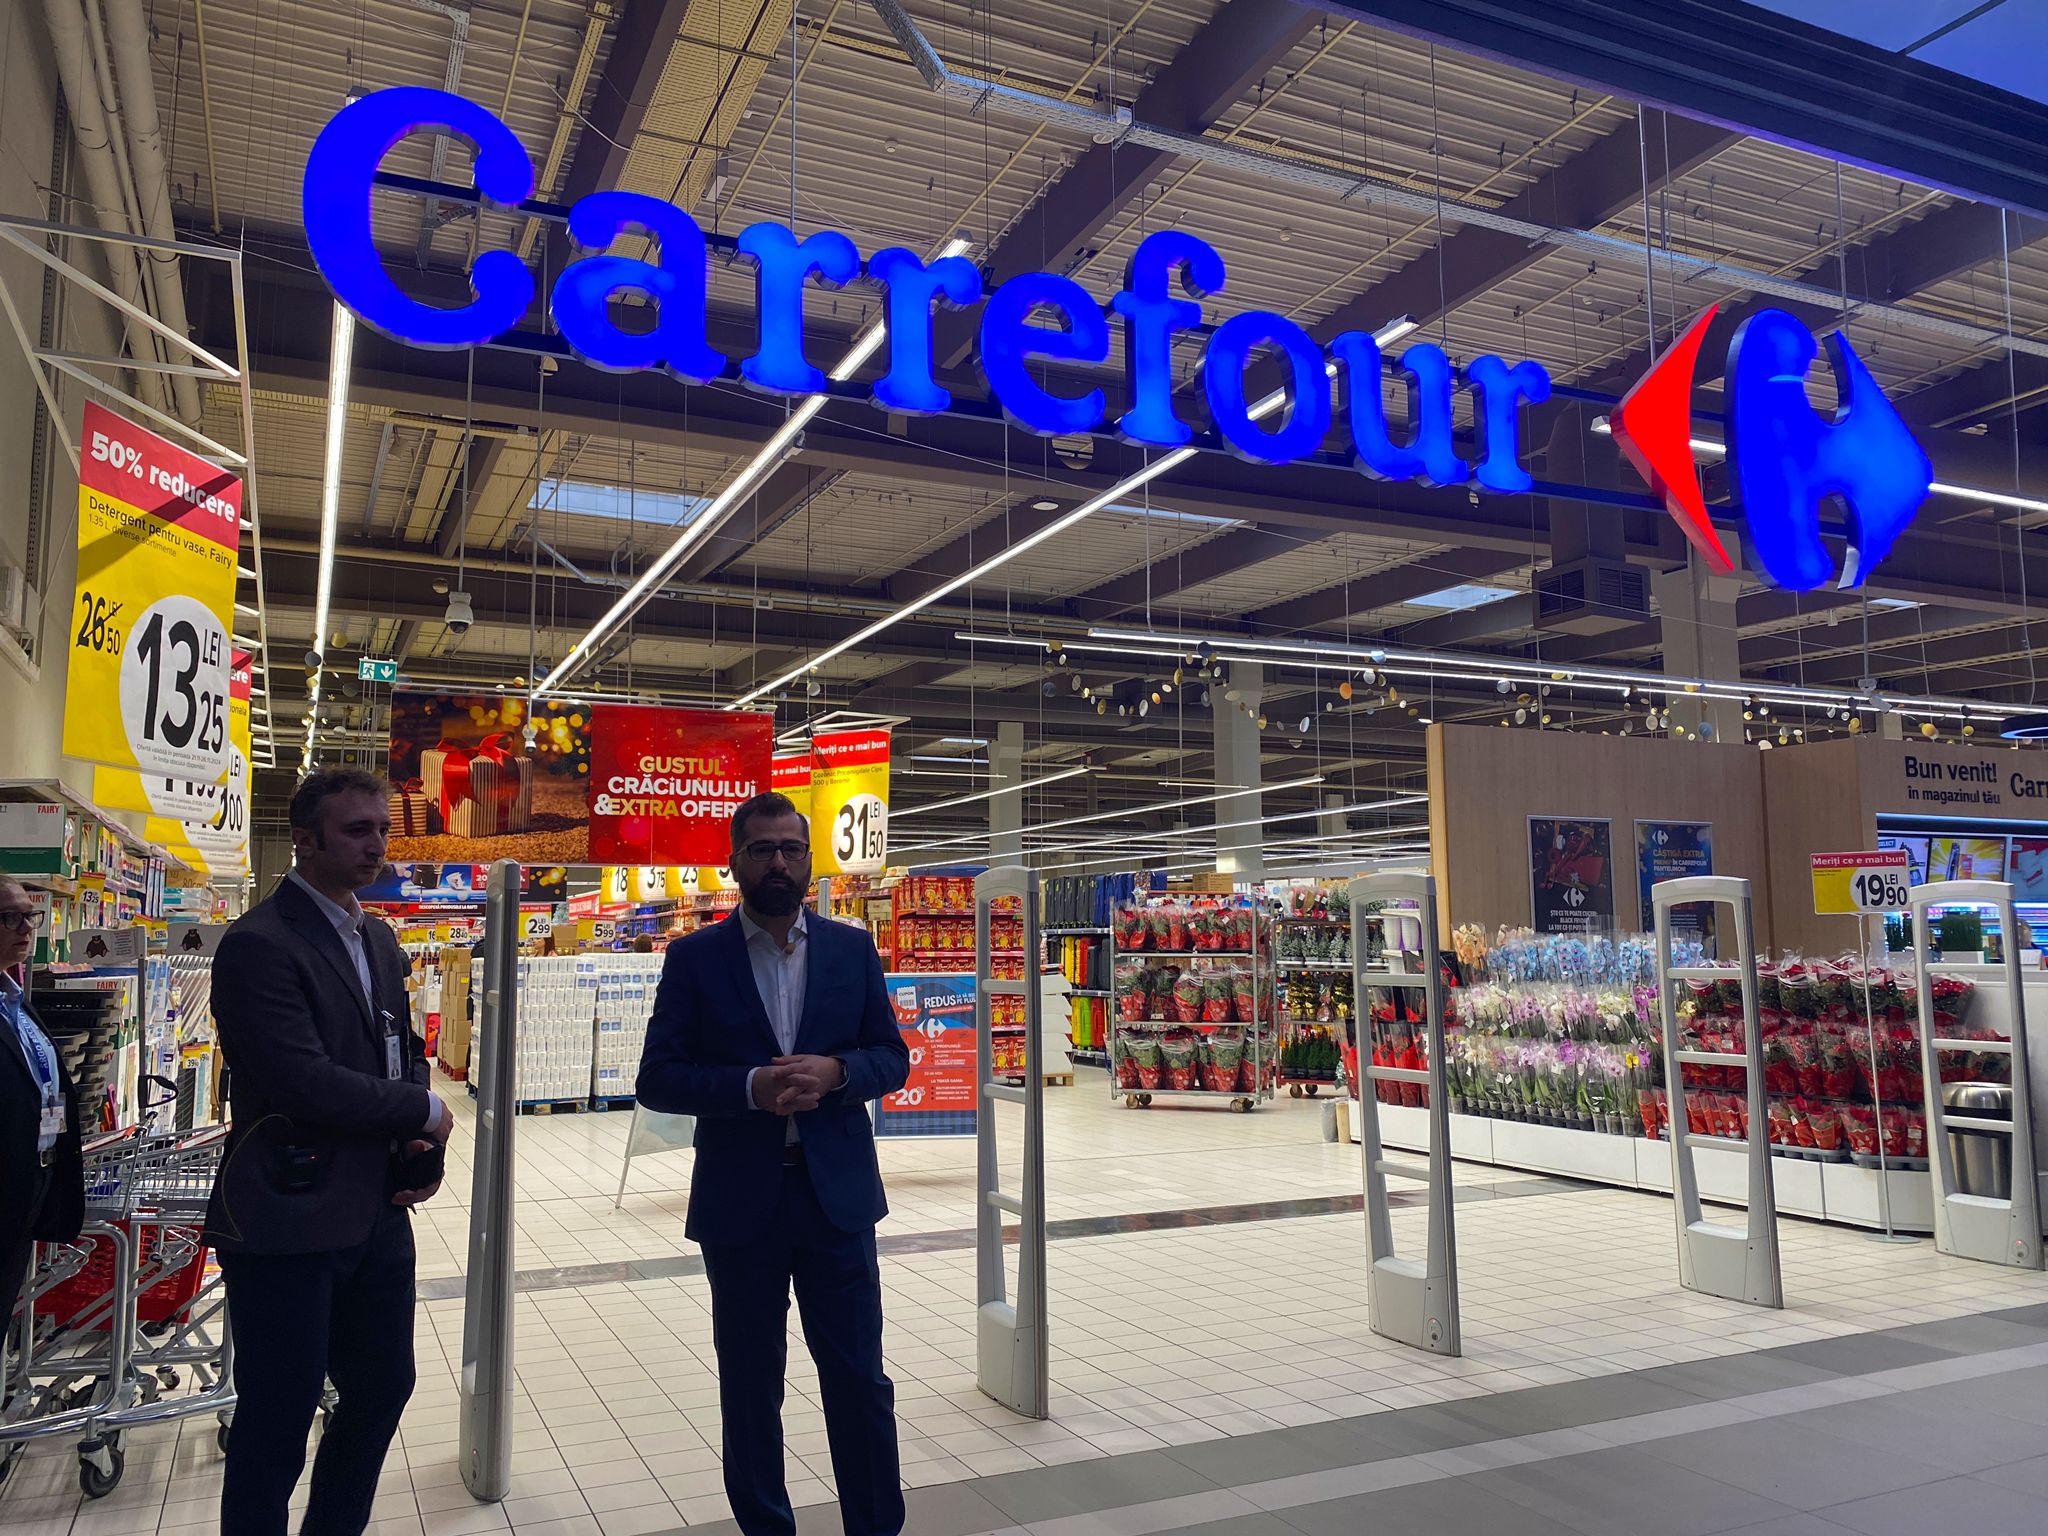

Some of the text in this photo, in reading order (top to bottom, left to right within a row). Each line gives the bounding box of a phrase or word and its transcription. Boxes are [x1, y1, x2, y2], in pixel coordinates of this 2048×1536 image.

[302, 86, 1552, 495] Carrefour
[90, 431, 236, 523] 50% reducere
[89, 495, 233, 570] Detergent pentru vase, Fairy
[112, 524, 141, 543] diverse
[141, 535, 177, 558] sortimente
[77, 591, 106, 651] 26
[106, 627, 121, 656] 50
[202, 628, 222, 668] LEI
[137, 612, 200, 749] 13
[230, 666, 249, 685] ere
[197, 690, 224, 754] 25
[814, 740, 887, 756] Meriți ce e mai bun
[639, 755, 726, 776] GUSTUL
[785, 765, 799, 775] mai
[1904, 755, 1998, 783] Bun venit!
[229, 754, 243, 832] LEI 00
[1907, 785, 2001, 805] în magazinul tău
[37, 805, 60, 814] FAIRY
[680, 799, 744, 818] OFER
[837, 801, 884, 862] 31 LEI 50
[1812, 856, 1841, 867] Meriți
[1865, 855, 1883, 864] mai
[1885, 855, 1905, 863] bun
[656, 872, 666, 888] 75
[1855, 873, 1908, 906] 19 LEI 90
[82, 890, 99, 904] 13 25
[450, 928, 460, 939] 28
[528, 918, 538, 934] 2
[537, 924, 551, 934] 99
[594, 923, 603, 937] 5
[603, 930, 614, 938] 99
[96, 981, 119, 990] FAIRY
[923, 994, 957, 1009] REDUS
[908, 1046, 927, 1066] 0%
